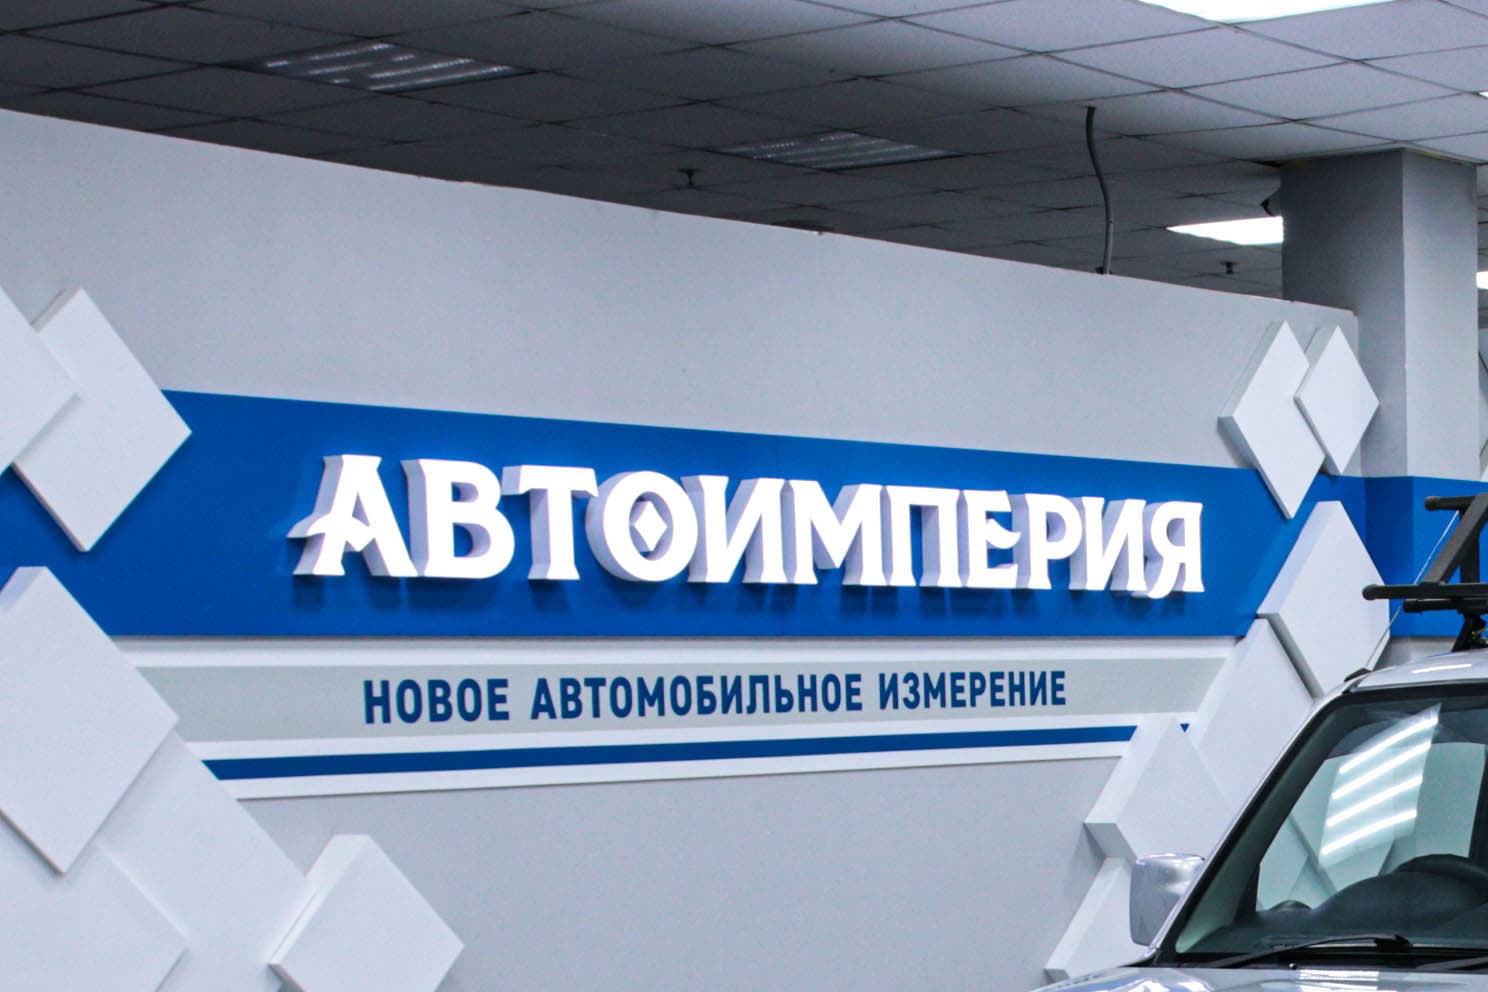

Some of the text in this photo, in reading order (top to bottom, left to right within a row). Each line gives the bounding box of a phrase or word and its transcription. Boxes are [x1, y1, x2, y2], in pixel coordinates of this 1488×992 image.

[288, 453, 1205, 600] АВТОИМПЕРИЯ
[363, 669, 1067, 725] НОВОЕ АВТОМОБИЛЬНОЕ ИЗМЕРЕНИЕ
